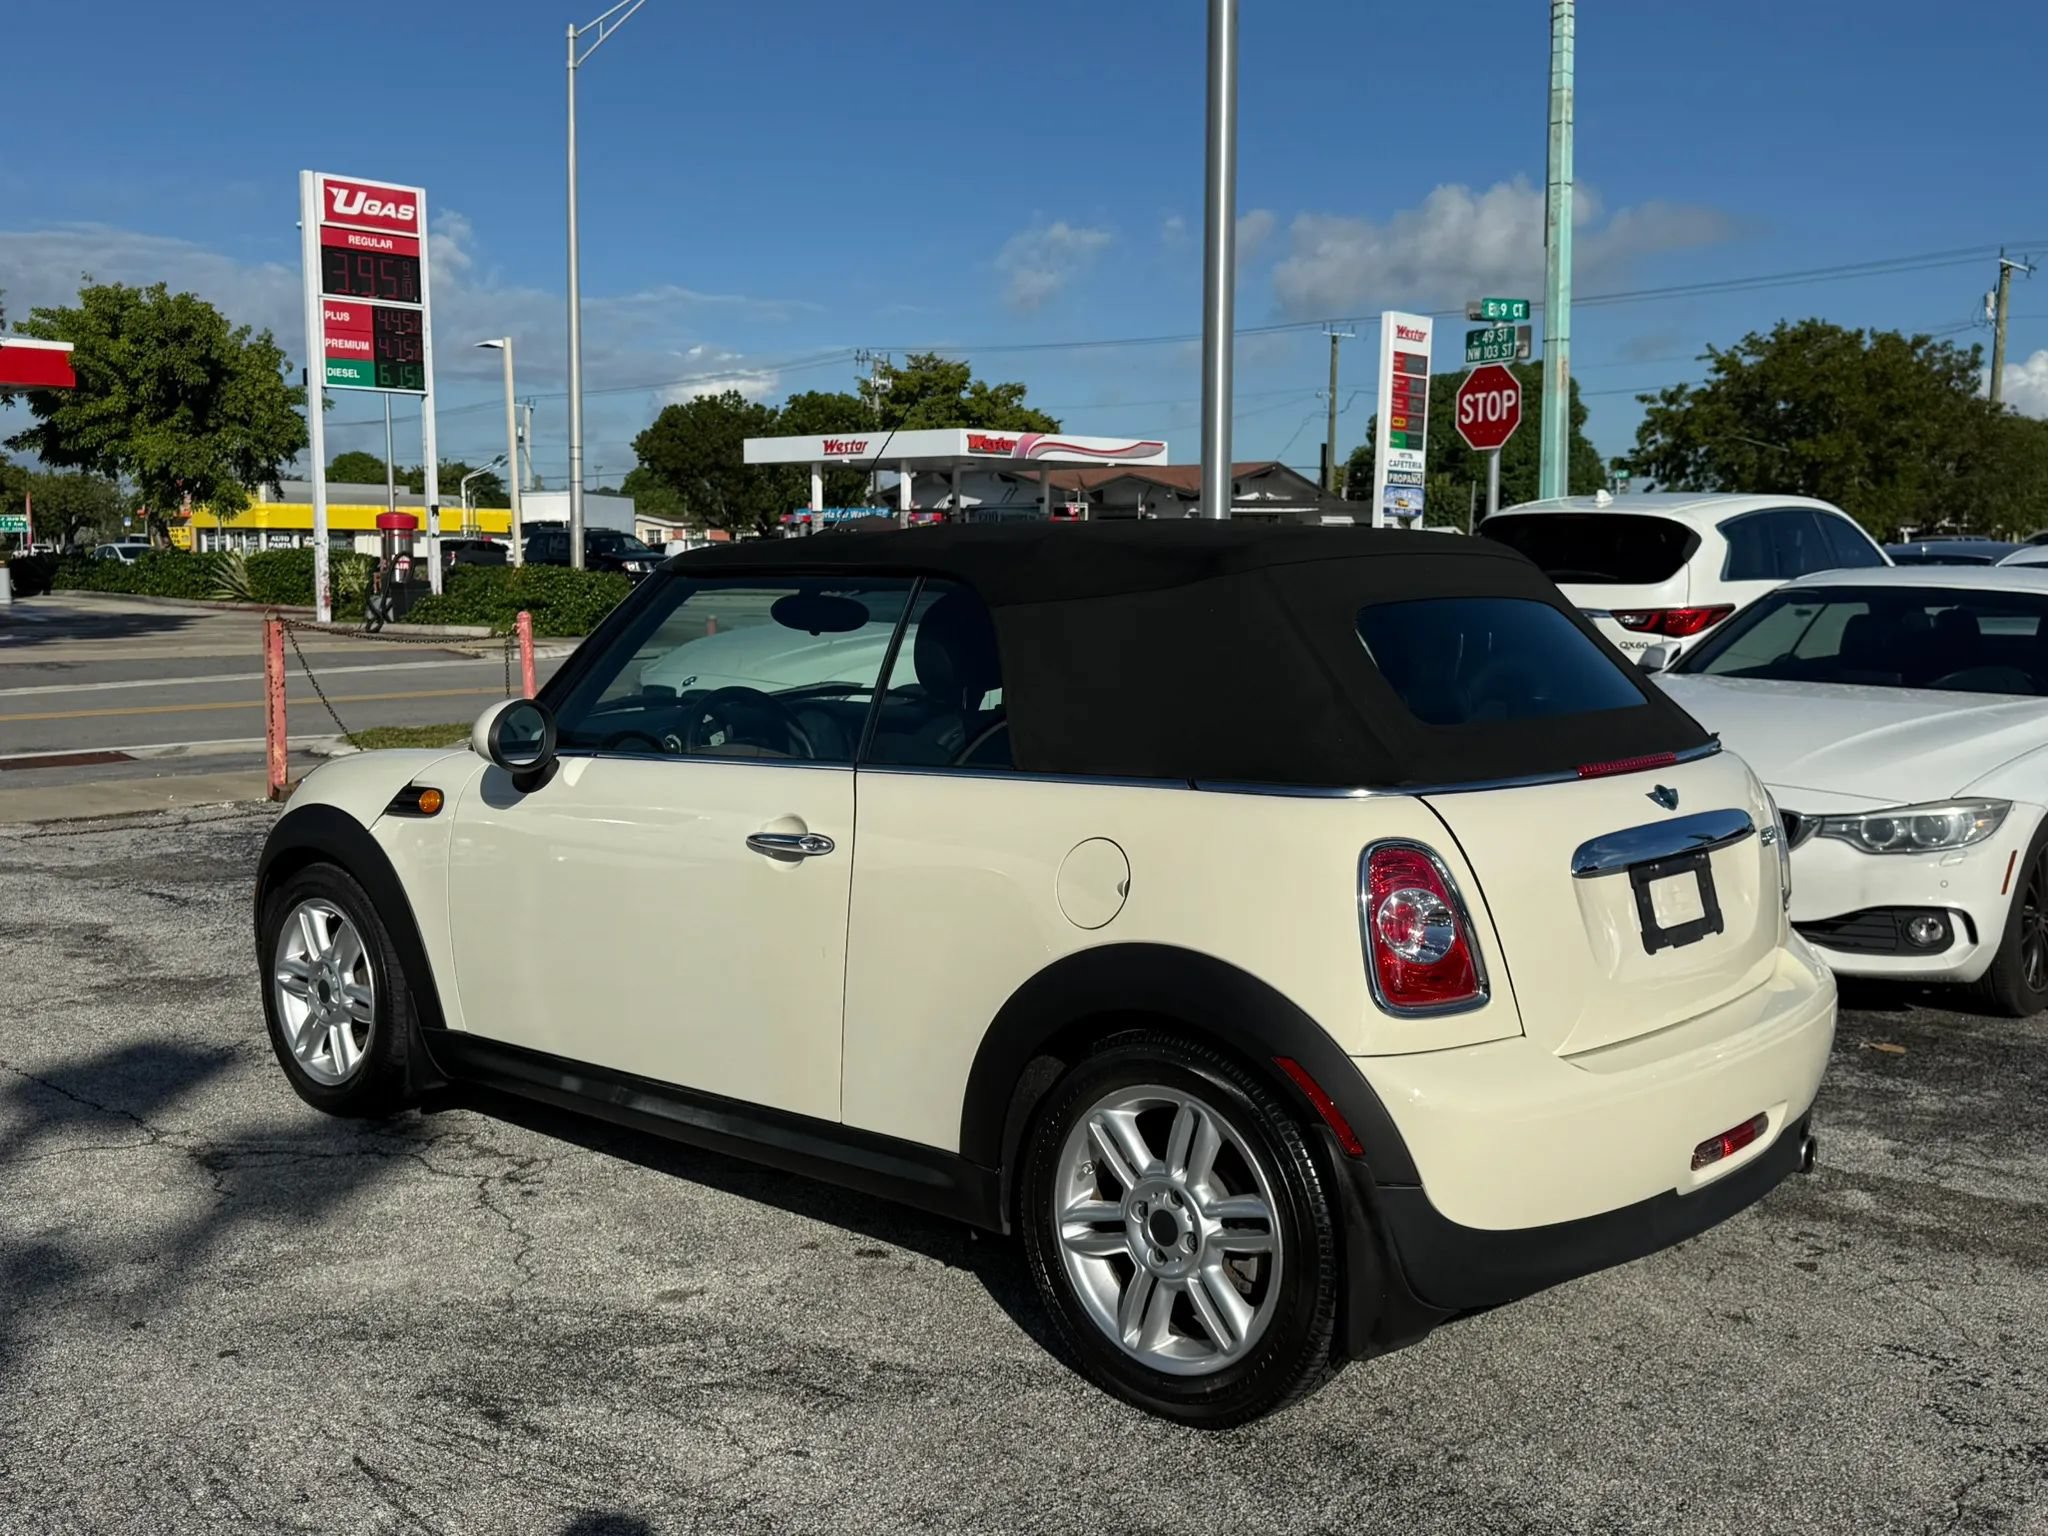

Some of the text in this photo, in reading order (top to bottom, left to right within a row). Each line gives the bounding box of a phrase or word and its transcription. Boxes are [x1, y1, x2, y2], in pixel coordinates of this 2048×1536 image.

[348, 234, 393, 250] REGULAR
[325, 310, 350, 322] PLUS
[1501, 303, 1507, 316] 9
[1513, 303, 1523, 317] CT
[1482, 330, 1495, 344] 49
[1497, 328, 1508, 342] ST
[325, 338, 369, 351] PREMIUM
[1468, 343, 1512, 361] NW 103 ST
[327, 367, 360, 379] DIESEL
[1460, 389, 1516, 425] STOP
[823, 438, 868, 455] Westar
[1388, 459, 1422, 469] CAFETERIA
[1619, 641, 1649, 650] QX60
